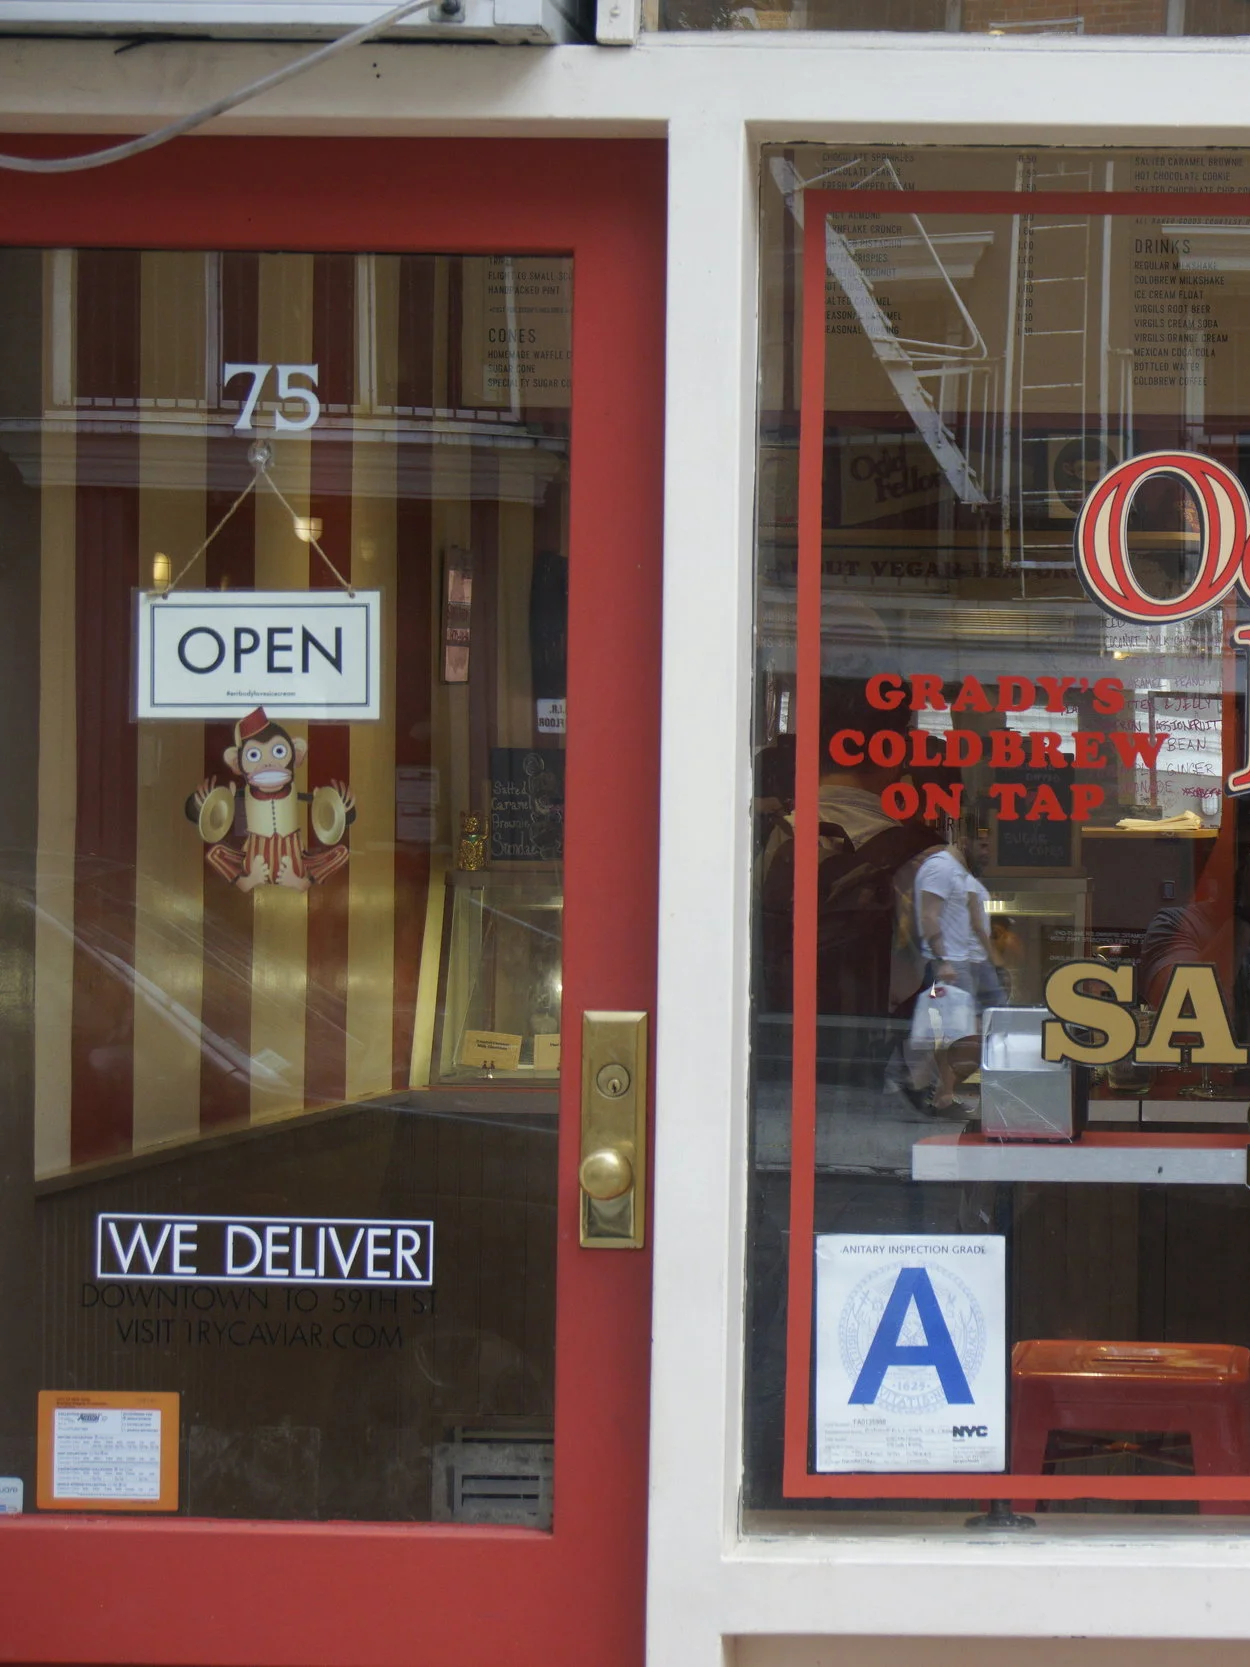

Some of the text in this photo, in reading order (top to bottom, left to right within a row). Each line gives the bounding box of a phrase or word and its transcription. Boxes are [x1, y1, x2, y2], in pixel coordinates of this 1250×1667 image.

[1135, 157, 1166, 167] SALTED
[1167, 157, 1206, 167] CARAMEL
[1134, 172, 1151, 181] HOT
[1153, 172, 1200, 181] CHOCOLATE
[1202, 172, 1231, 181] COOKIE
[1134, 239, 1192, 255] DRINKS
[1134, 261, 1170, 270] REGULAR
[1134, 276, 1176, 285] COLDBREW
[1179, 276, 1225, 285] MILKSHAKE
[1134, 290, 1147, 299] ICE
[1149, 290, 1176, 299] CREAM
[1178, 290, 1204, 299] FLOAT
[1134, 304, 1166, 314] VIRGILS
[1167, 304, 1188, 314] ROOT
[1191, 304, 1211, 314] BEER
[1134, 319, 1166, 328] VIRGILS
[1167, 319, 1195, 328] CREAM
[488, 328, 537, 343] CONES
[1134, 333, 1166, 343] VIRGILS
[1134, 348, 1169, 357] MEXICAN
[1134, 363, 1169, 372] BOTTLED
[1134, 377, 1176, 386] COLDBREW
[224, 362, 321, 432] 75
[178, 626, 343, 675] OPEN
[865, 673, 1125, 714] GRADY'S
[1167, 737, 1207, 752] BEAN
[1166, 762, 1216, 777] GINGER
[492, 780, 528, 796] Salted
[491, 799, 532, 811] Caramel
[880, 782, 1105, 821] ON TAP
[107, 1222, 423, 1280] WE DELIVER
[840, 1244, 987, 1256] ANITARY INSPECTION GRADE
[80, 1282, 438, 1316] DOWNTOWN TO 59TH ST
[116, 1317, 177, 1345] VISIT
[847, 1267, 976, 1406] A
[952, 1424, 989, 1438] NYC
